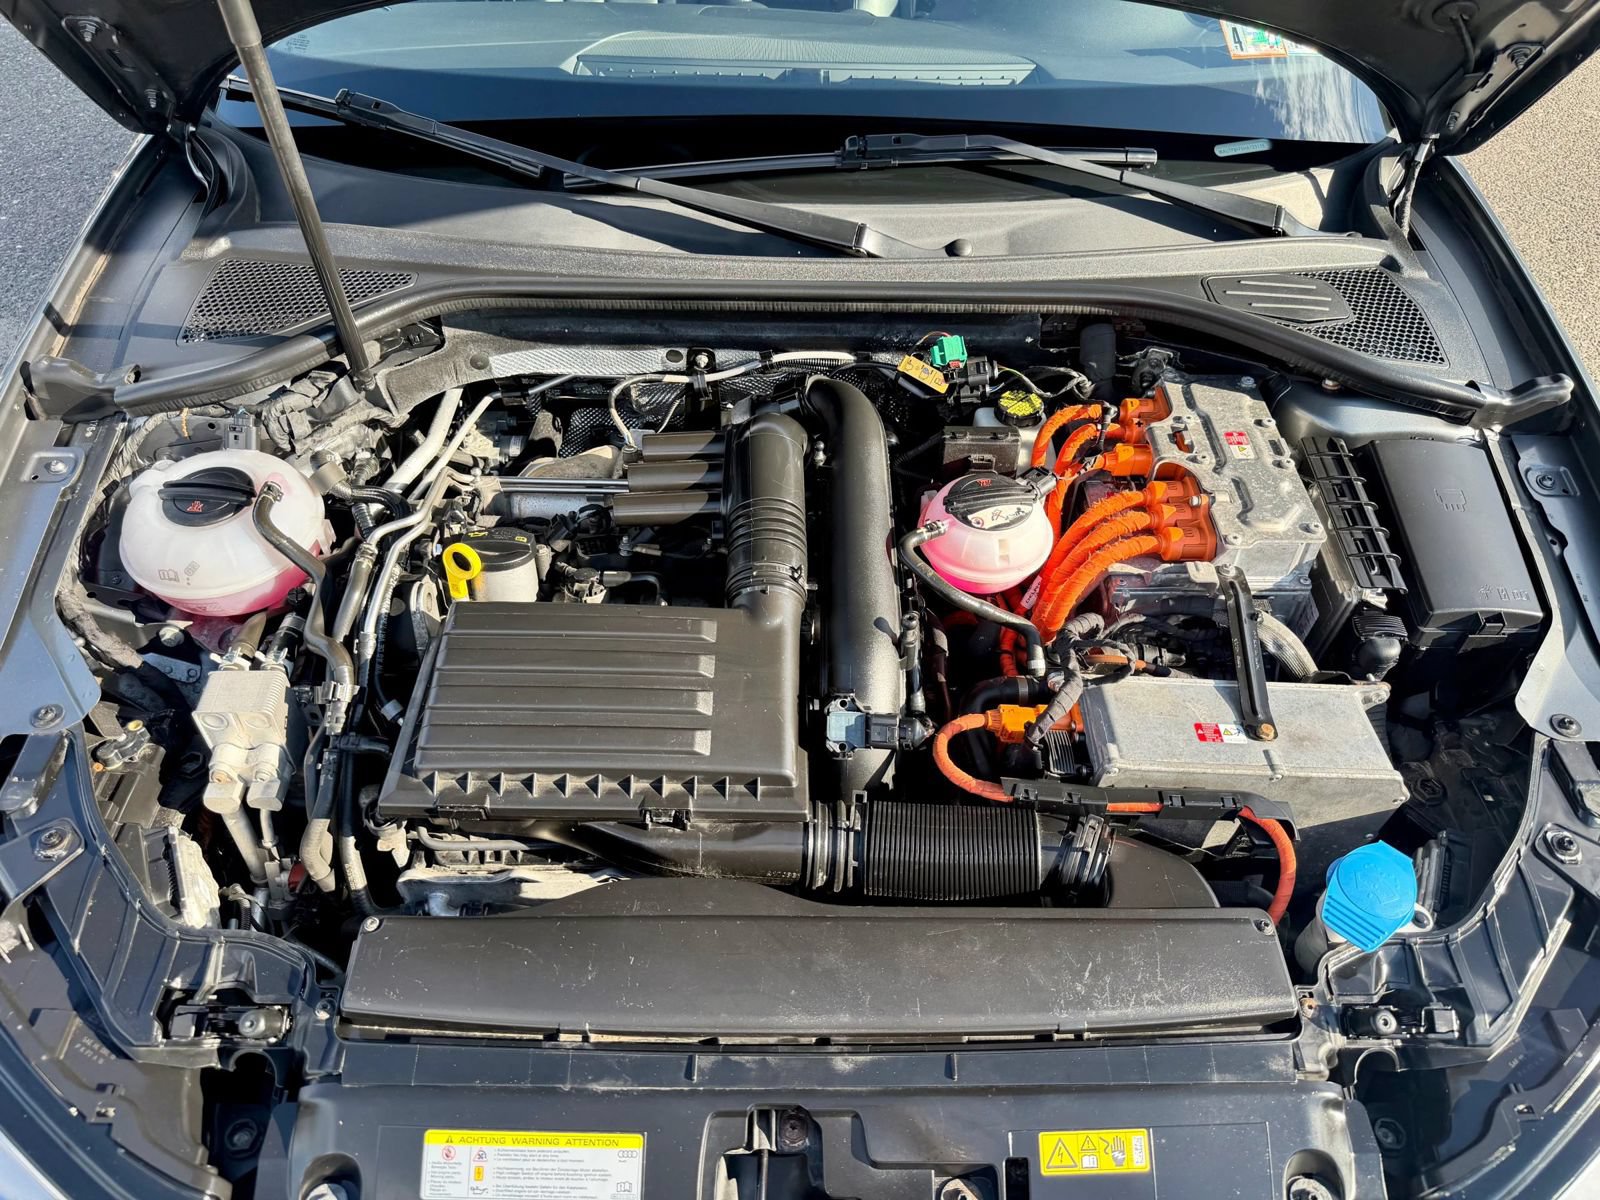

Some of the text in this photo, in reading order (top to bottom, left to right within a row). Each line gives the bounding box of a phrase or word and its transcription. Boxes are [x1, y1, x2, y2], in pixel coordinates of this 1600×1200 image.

[1231, 26, 1243, 51] 4
[458, 1135, 620, 1147] ACHTUNG WARNING ATTENTION
